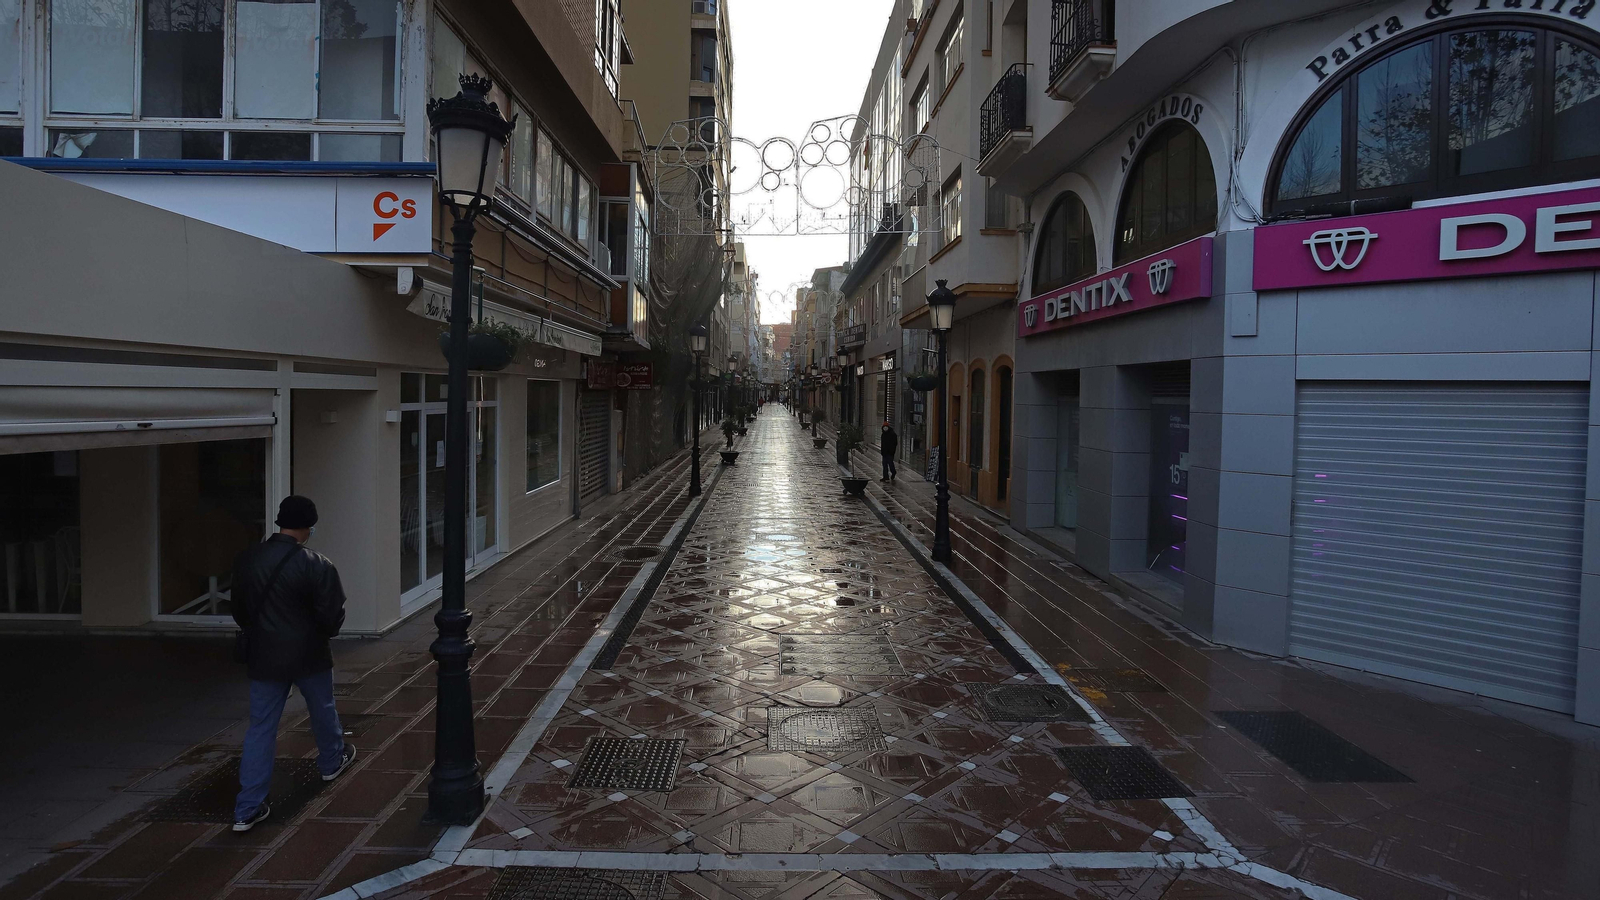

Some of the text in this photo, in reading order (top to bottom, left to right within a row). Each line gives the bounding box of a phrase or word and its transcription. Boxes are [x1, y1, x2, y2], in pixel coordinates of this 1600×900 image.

[1306, 15, 1404, 82] Parra
[1425, 0, 1453, 20] &
[1121, 96, 1204, 173] ABOGADOS
[373, 191, 417, 219] Cs
[1439, 201, 1600, 261] DE
[1044, 272, 1133, 323] DENTIX
[1169, 464, 1180, 485] 15
